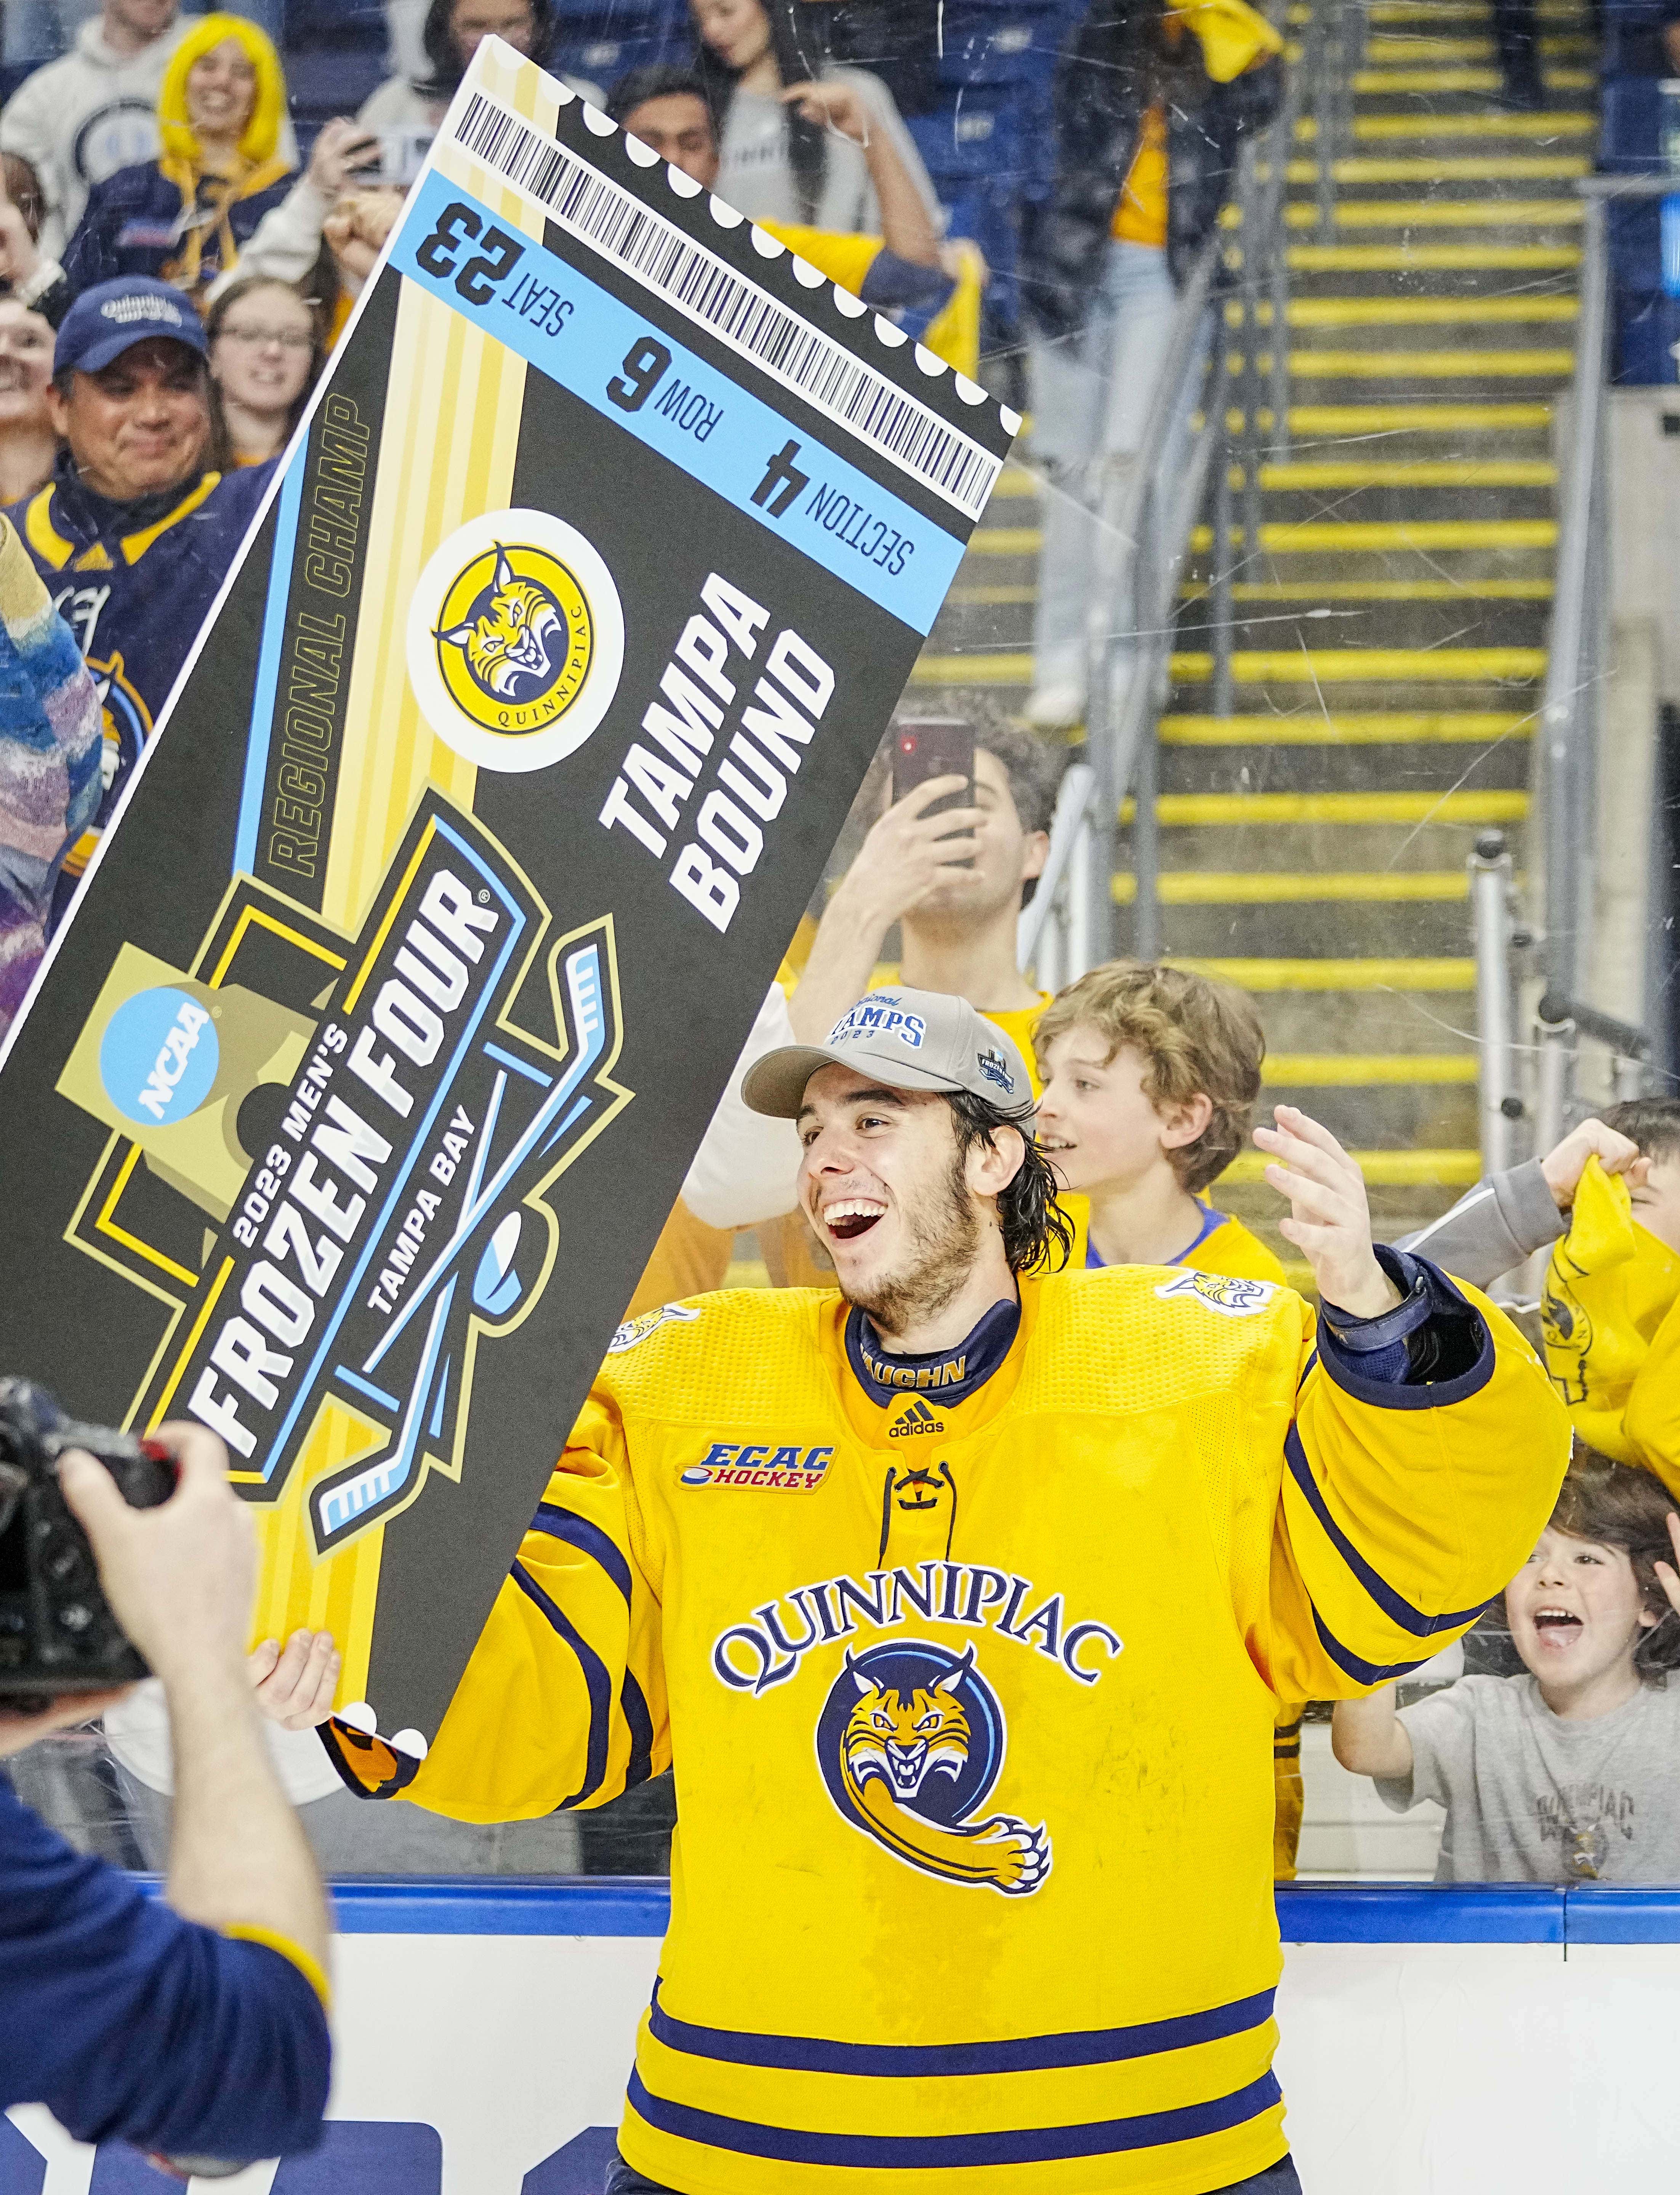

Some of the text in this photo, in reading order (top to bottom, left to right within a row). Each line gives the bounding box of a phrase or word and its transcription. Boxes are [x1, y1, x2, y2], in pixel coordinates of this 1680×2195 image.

[415, 202, 914, 576] SECTION 4 ROW 6 SEAT 23
[269, 393, 370, 878] REGIONAL CHAMP
[498, 605, 586, 728] QUINNIPIAC
[598, 572, 771, 860] TAMPA
[669, 628, 835, 934] BOUND
[138, 1001, 210, 1120] NCAA
[830, 1030, 875, 1045] 2023
[232, 1022, 348, 1248] 2023 MEN'S
[188, 1093, 393, 1459] FROZEN
[367, 1105, 477, 1315] TAMPA BAY
[860, 1343, 966, 1388] AUGHN
[889, 1421, 945, 1438] adidas
[700, 1444, 834, 1471] ECAC
[713, 1469, 824, 1488] HOCKEY
[713, 1562, 1123, 1696] QUINNIPIAC
